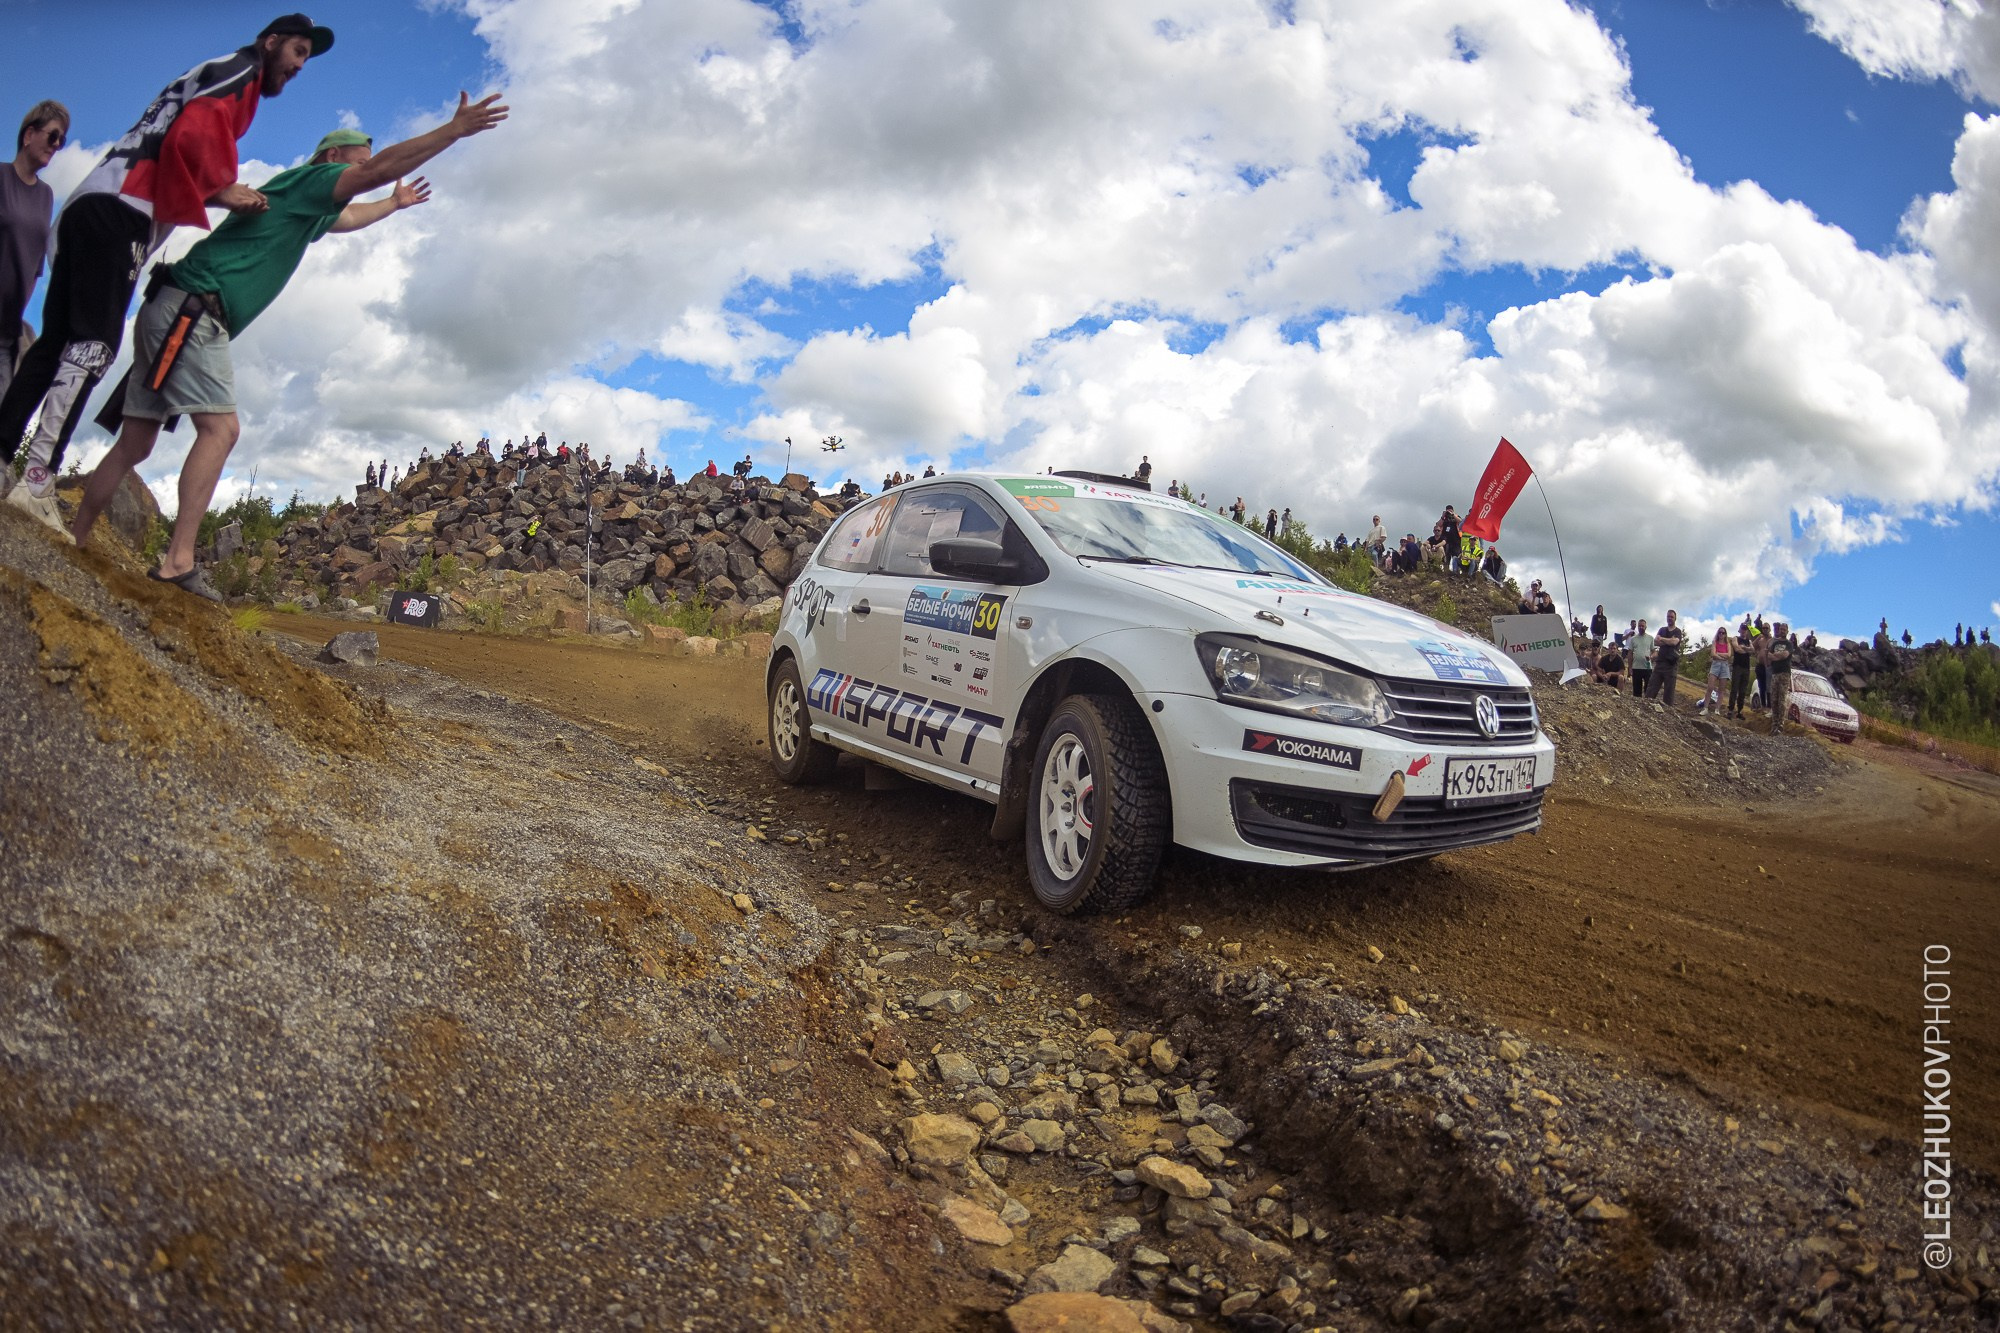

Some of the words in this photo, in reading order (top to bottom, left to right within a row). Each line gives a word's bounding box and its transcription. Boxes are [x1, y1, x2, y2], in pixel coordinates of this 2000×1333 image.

[1015, 495, 1061, 512] 30
[866, 495, 898, 538] 30
[794, 577, 835, 638] SPOT
[906, 597, 941, 615] БЕЛЫЕ
[940, 603, 975, 621] НОЧИ
[973, 600, 1001, 630] 30
[931, 641, 960, 654] ТАТНЕФТЬ
[1510, 639, 1566, 653] ТАТНЕФТЬ
[1425, 653, 1470, 668] БЕЛЫЕ
[1466, 658, 1498, 672] НОЧИ
[1276, 739, 1353, 765] YOKOHAMA
